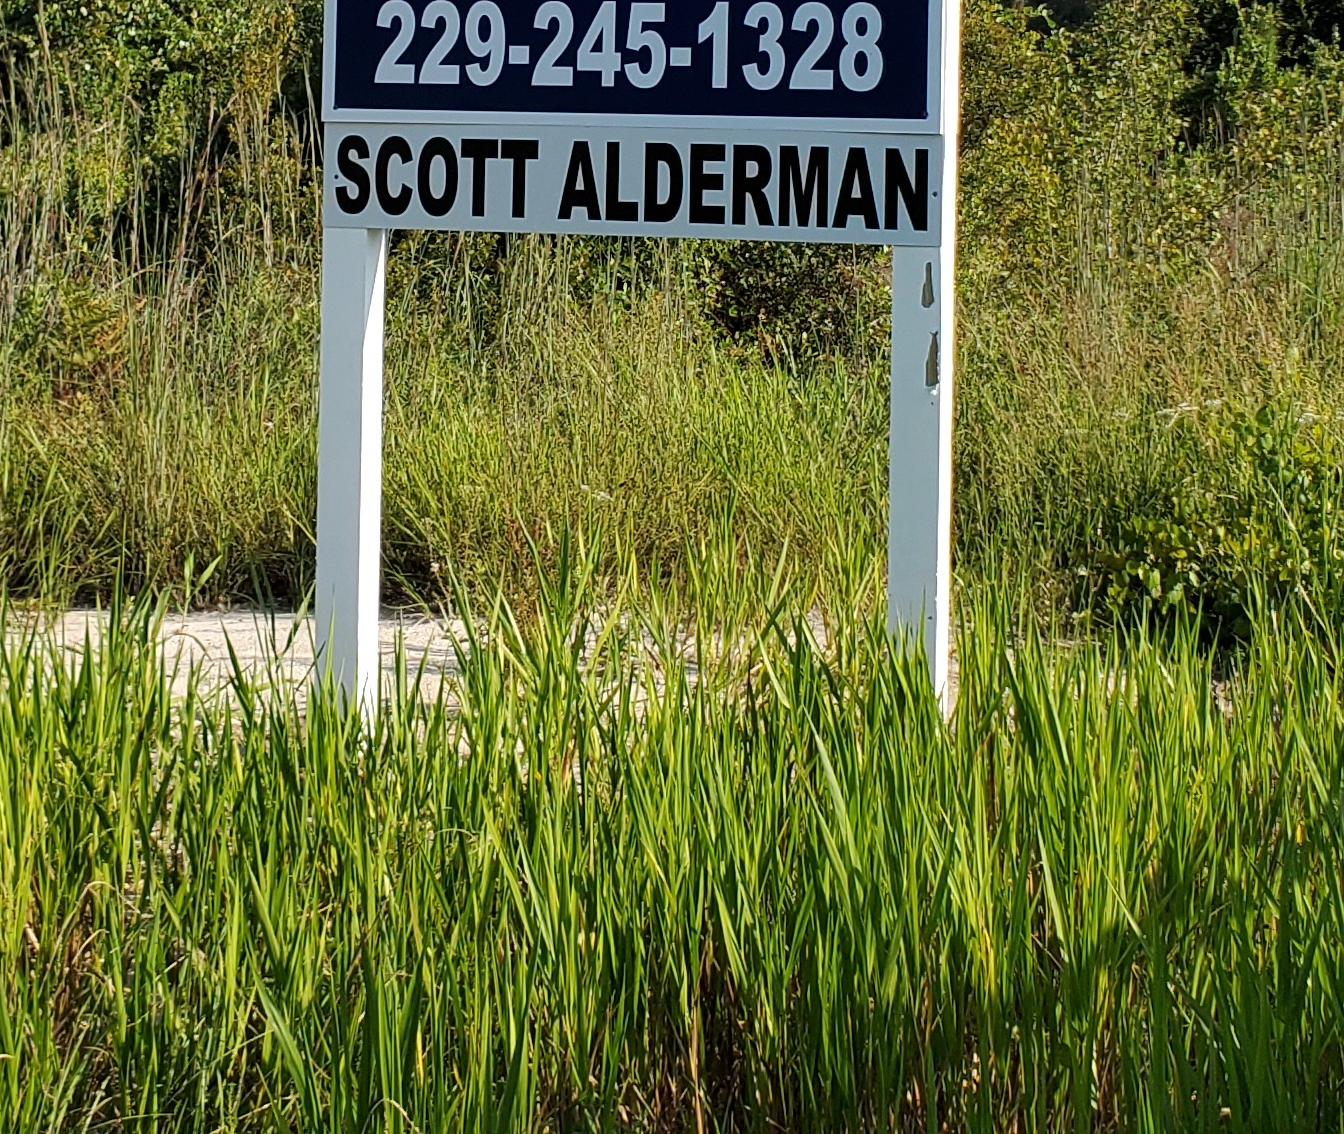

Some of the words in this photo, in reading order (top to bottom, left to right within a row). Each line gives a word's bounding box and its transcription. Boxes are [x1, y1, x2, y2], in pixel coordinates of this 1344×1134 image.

[373, 0, 883, 91] 229-245-1328
[334, 135, 539, 219] SCOTT
[558, 140, 929, 231] ALDERMAN
